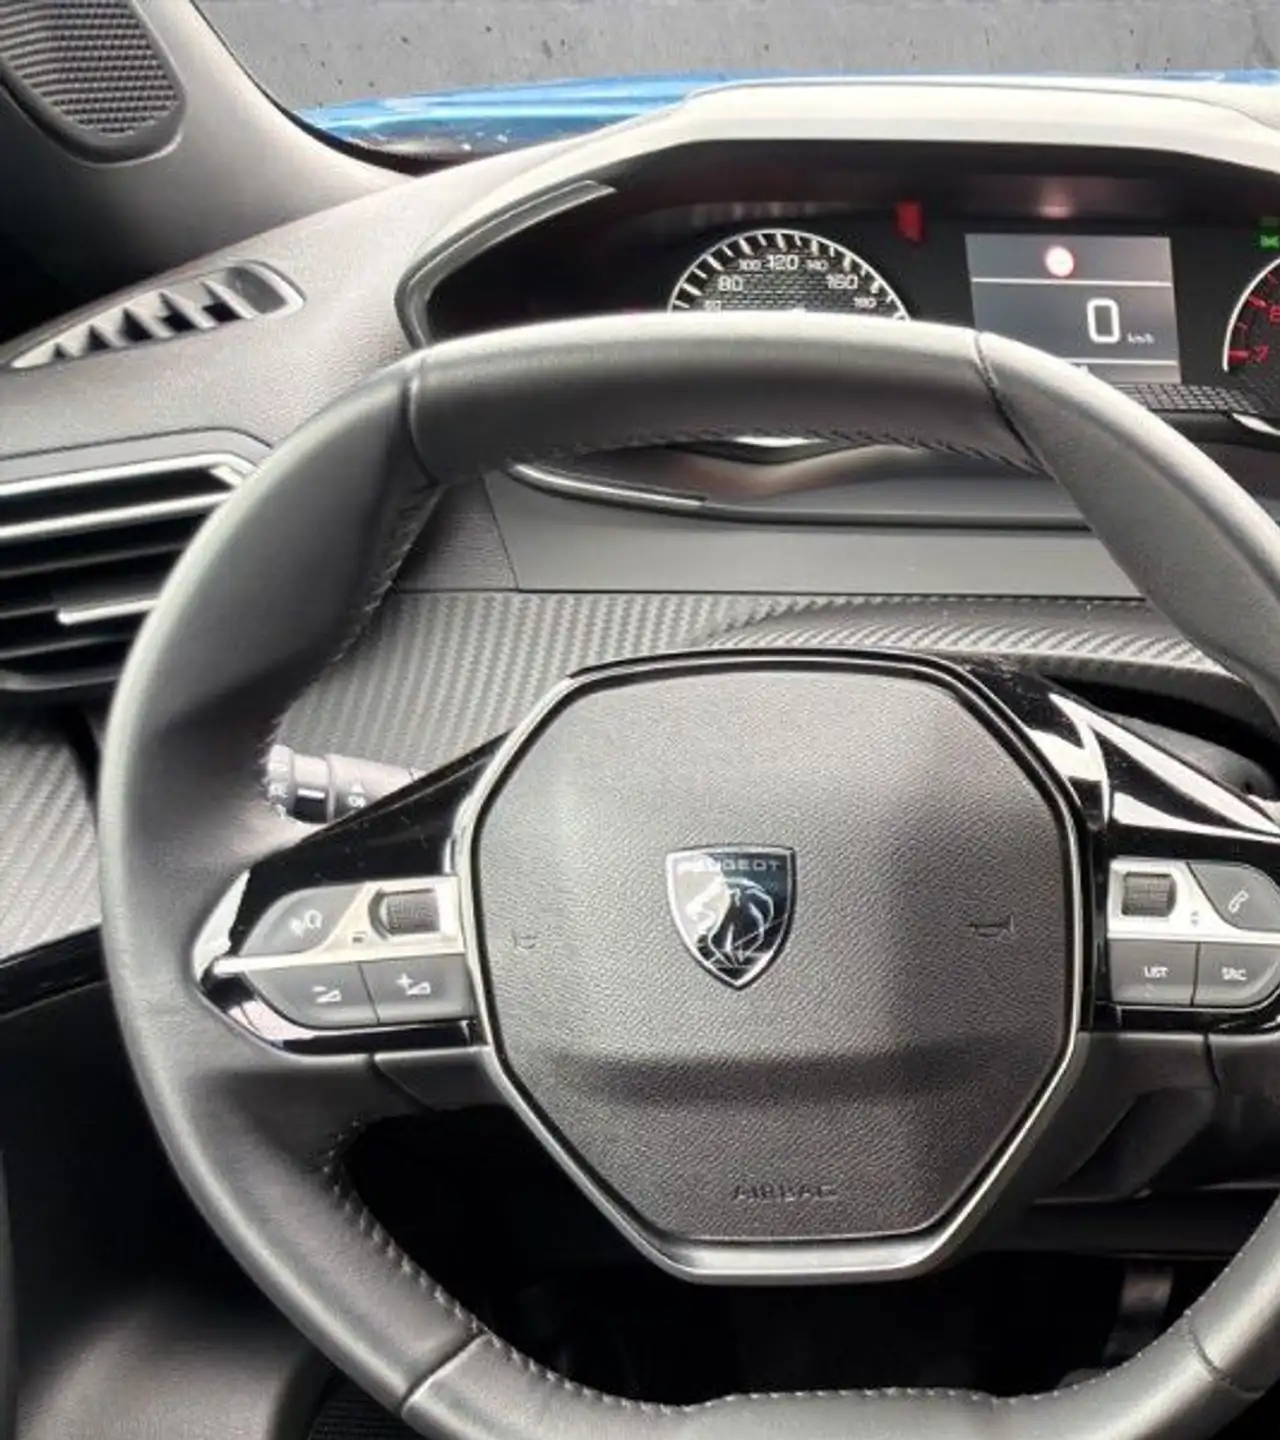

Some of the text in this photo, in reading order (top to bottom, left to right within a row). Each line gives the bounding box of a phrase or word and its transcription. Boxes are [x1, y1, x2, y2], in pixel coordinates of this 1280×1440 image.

[769, 254, 799, 270] 120
[718, 275, 744, 291] 80
[827, 273, 858, 289] 160
[1087, 298, 1120, 344] 0
